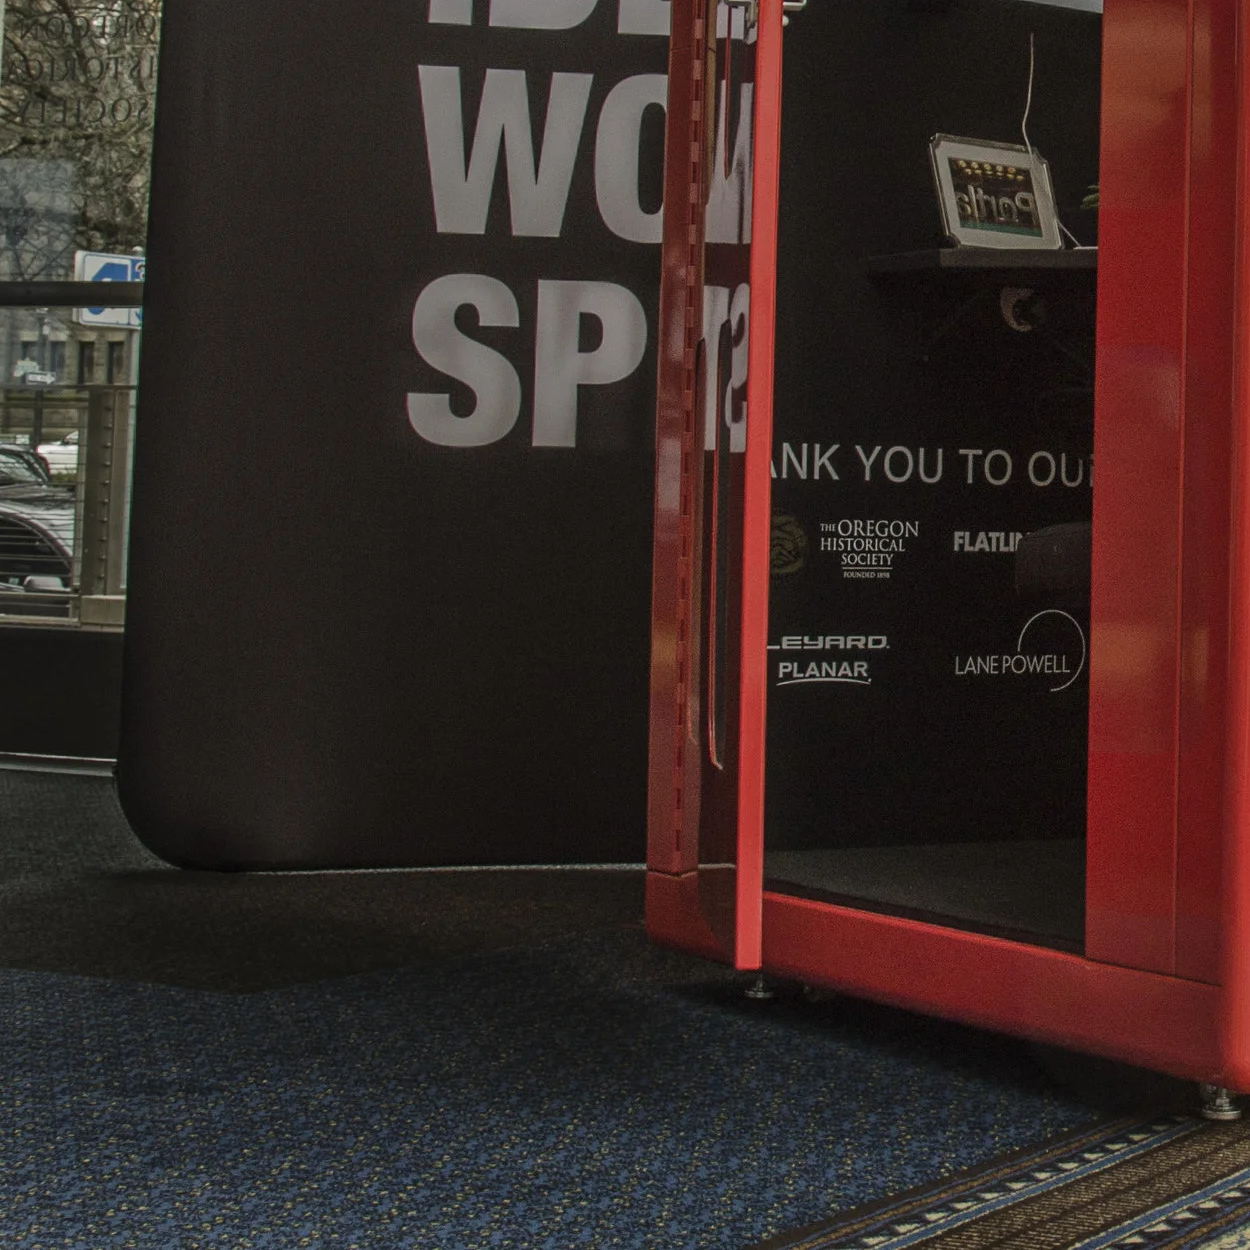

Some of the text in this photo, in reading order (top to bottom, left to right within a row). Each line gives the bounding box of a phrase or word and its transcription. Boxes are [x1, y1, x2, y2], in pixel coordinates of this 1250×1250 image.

[770, 442, 1094, 488] NK YOU TO OU
[820, 519, 919, 538] THE OREGON
[820, 537, 906, 552] HISTORICAL
[841, 553, 894, 565] SOCIETY
[843, 571, 875, 579] FOUNDED
[778, 661, 868, 678] PLANAR
[955, 654, 1070, 675] LANE POWELL
